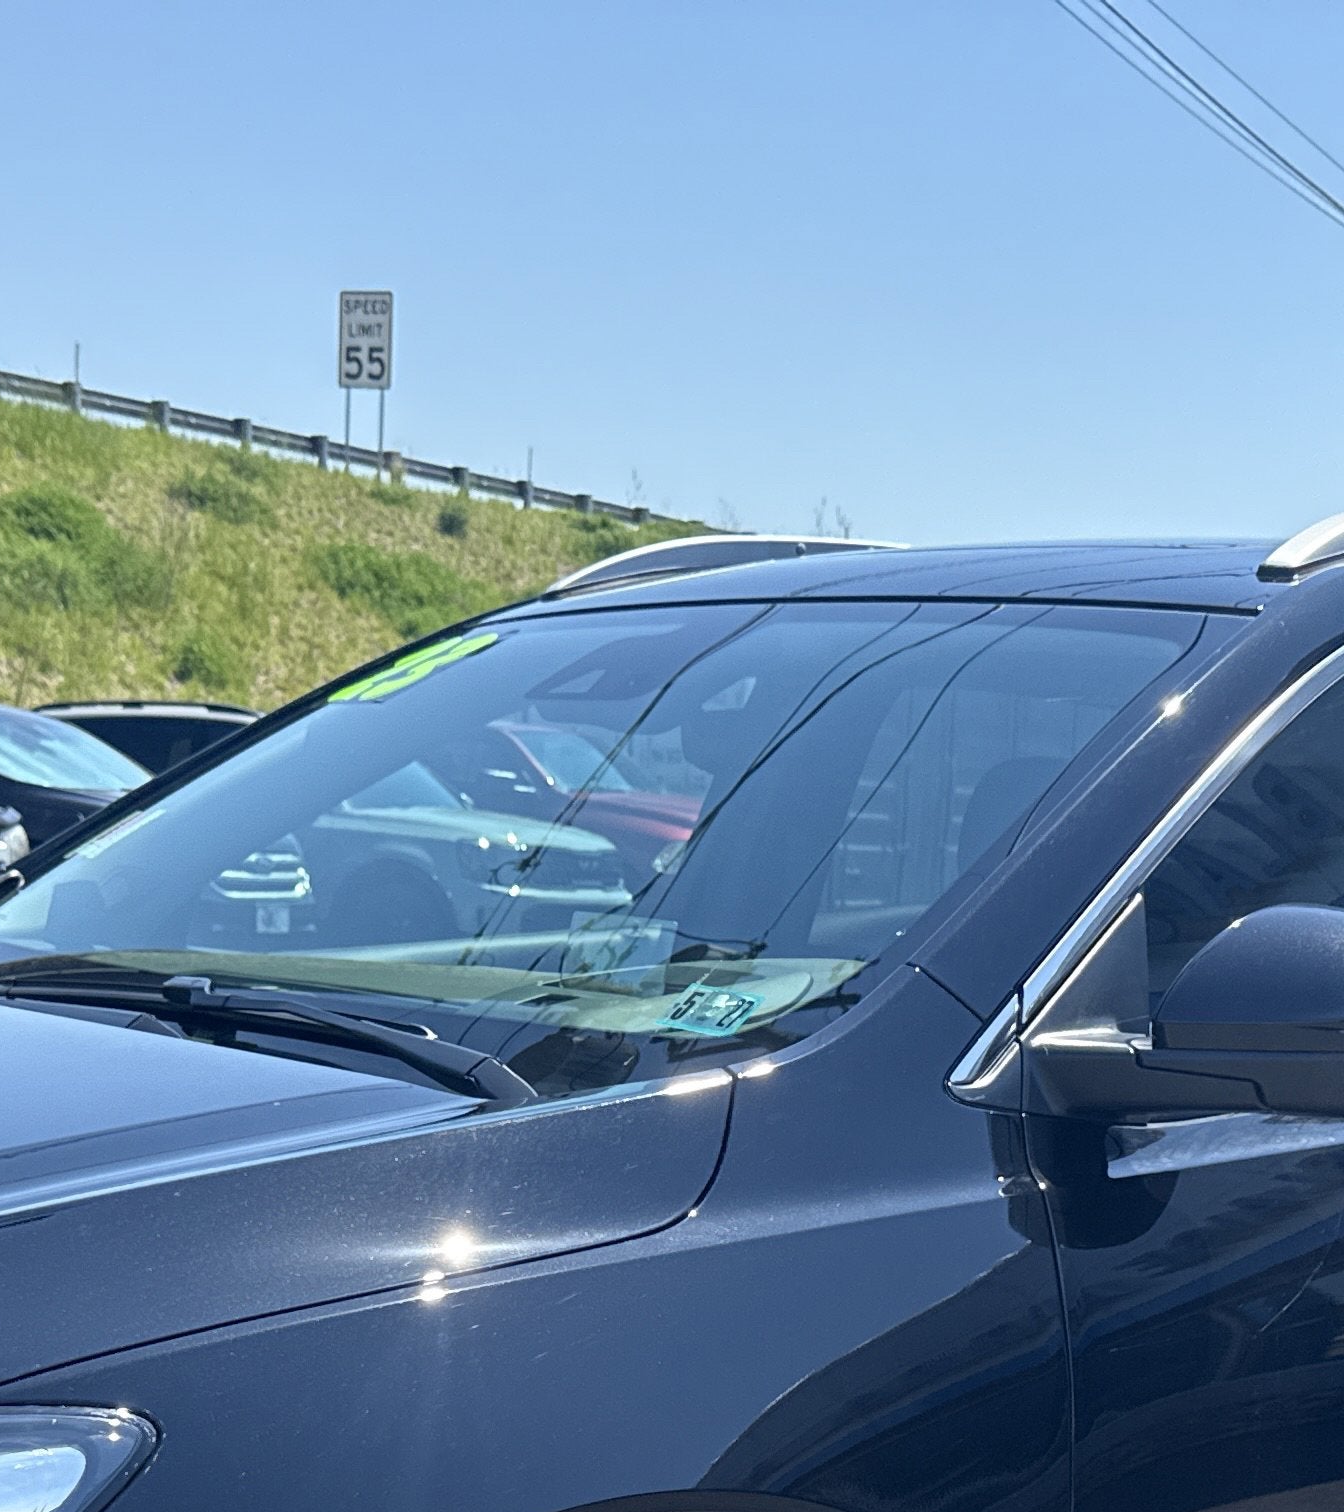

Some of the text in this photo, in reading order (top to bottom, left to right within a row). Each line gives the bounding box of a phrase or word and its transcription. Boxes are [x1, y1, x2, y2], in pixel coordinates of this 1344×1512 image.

[343, 299, 390, 315] SPEED
[347, 322, 384, 339] LIMIT
[344, 346, 386, 381] 55
